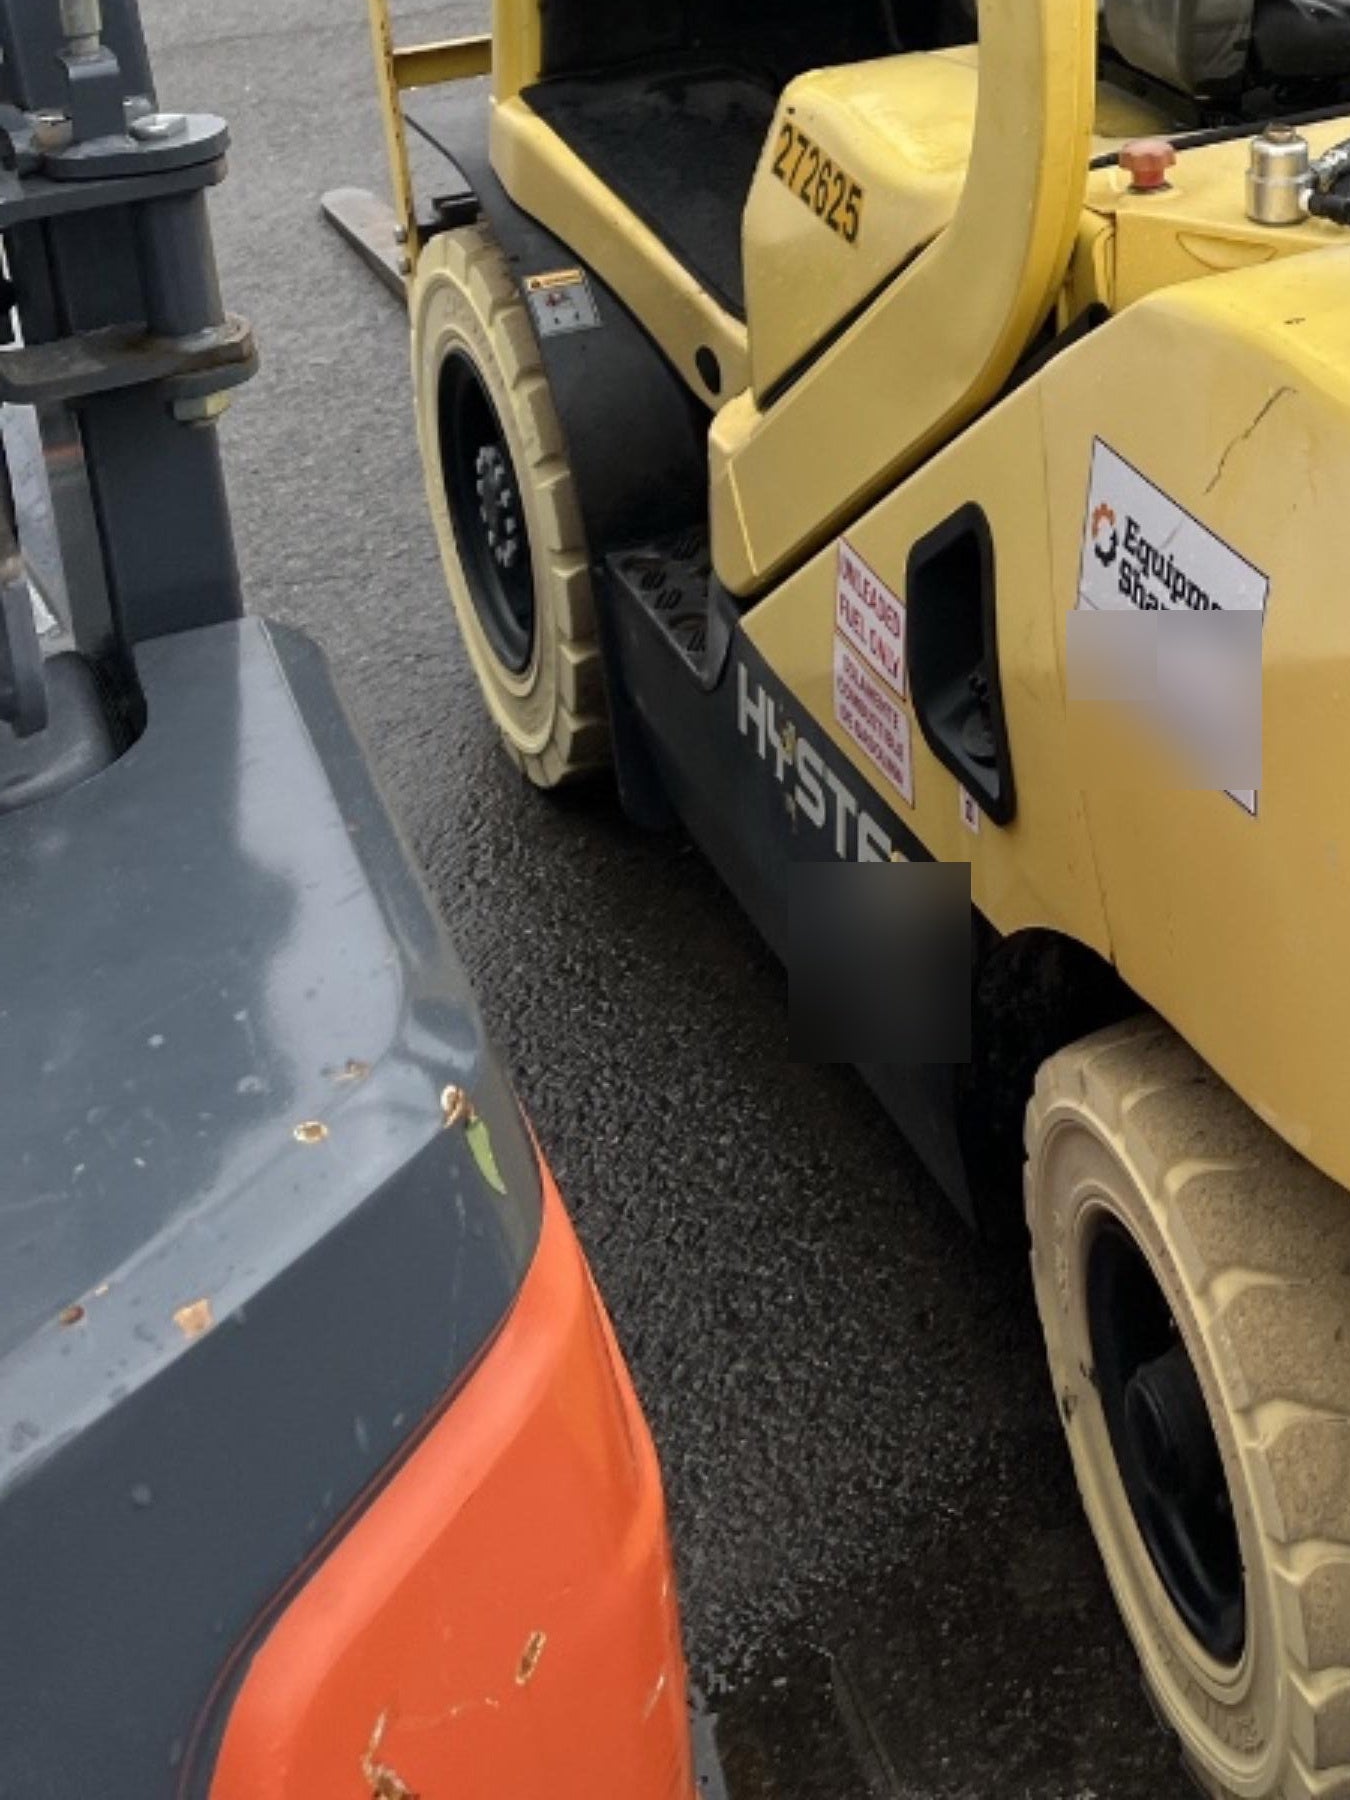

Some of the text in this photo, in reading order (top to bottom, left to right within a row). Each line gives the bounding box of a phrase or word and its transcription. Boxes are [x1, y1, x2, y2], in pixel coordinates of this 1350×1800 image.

[771, 121, 864, 245] 272625
[1117, 558, 1171, 611] Sha
[1122, 514, 1224, 611] Equipm
[736, 662, 894, 862] HYST
